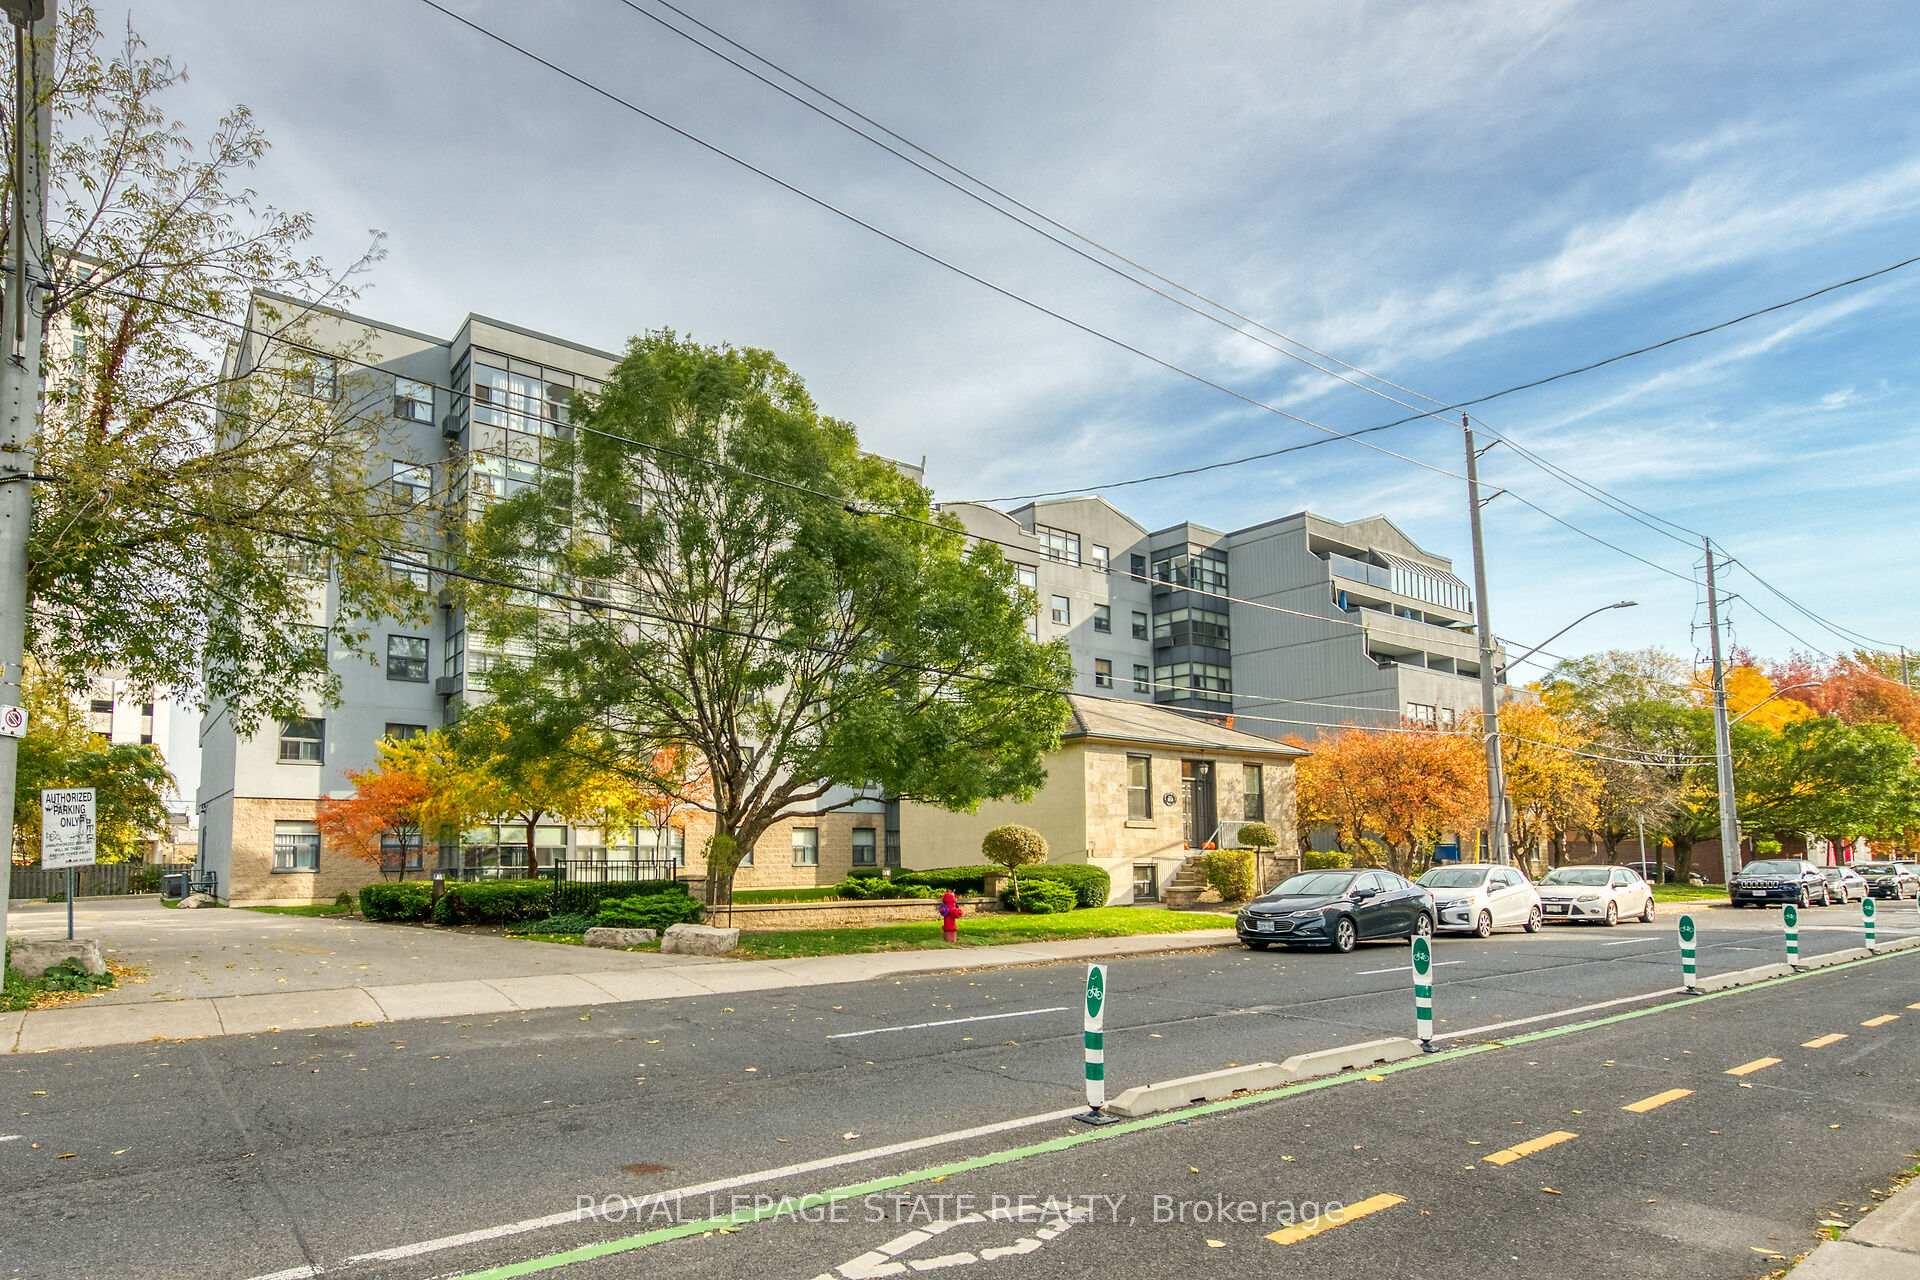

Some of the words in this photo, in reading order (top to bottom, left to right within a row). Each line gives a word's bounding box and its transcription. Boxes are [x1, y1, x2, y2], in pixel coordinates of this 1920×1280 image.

[46, 792, 92, 803] AUTHORIZED
[53, 804, 86, 815] PARKING
[60, 816, 79, 828] ONLY
